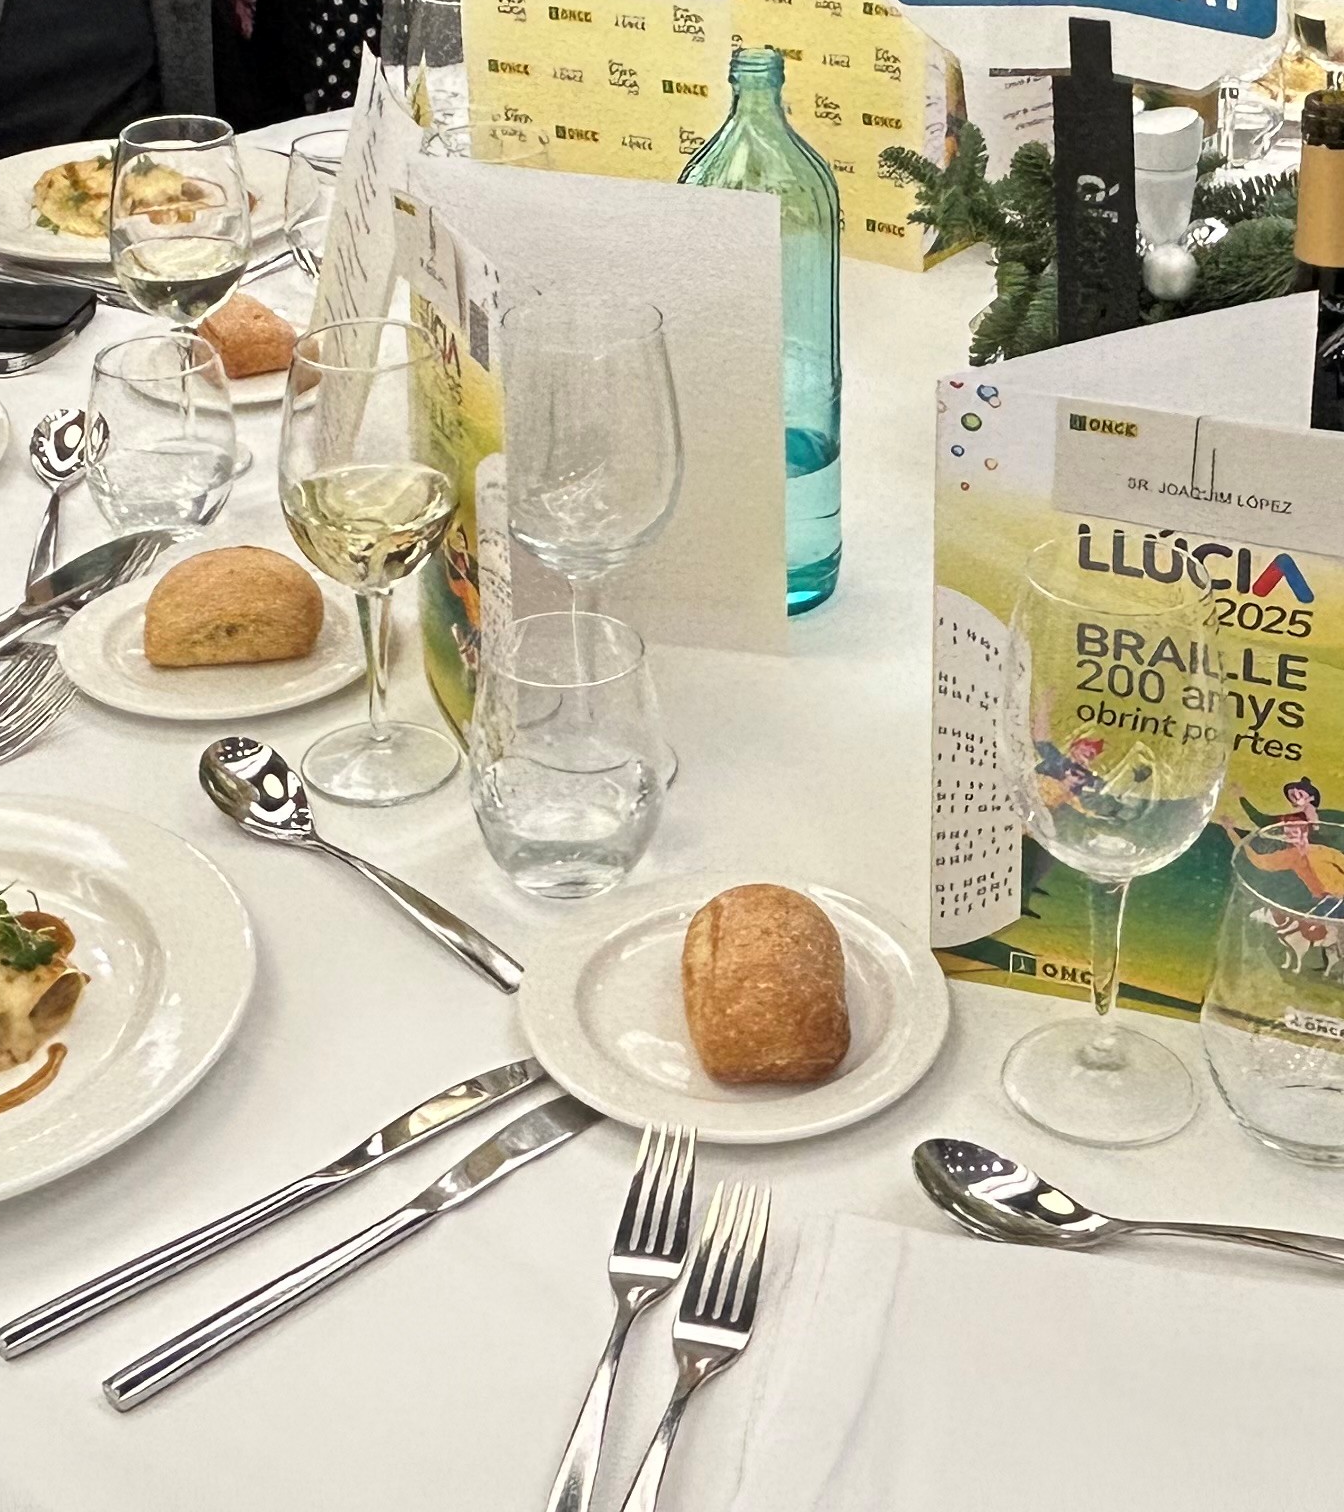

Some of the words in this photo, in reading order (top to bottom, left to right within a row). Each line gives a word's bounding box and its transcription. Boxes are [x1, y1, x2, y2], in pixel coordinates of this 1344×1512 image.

[1089, 418, 1137, 437] ONCE
[1078, 523, 1315, 604] LLÚCIA
[1211, 597, 1315, 638] 2025
[1076, 622, 1310, 692] BRAILLE
[1076, 659, 1166, 704] 200
[1182, 685, 1306, 731] anys
[1076, 701, 1177, 738] obrint
[1042, 962, 1095, 985] ONC
